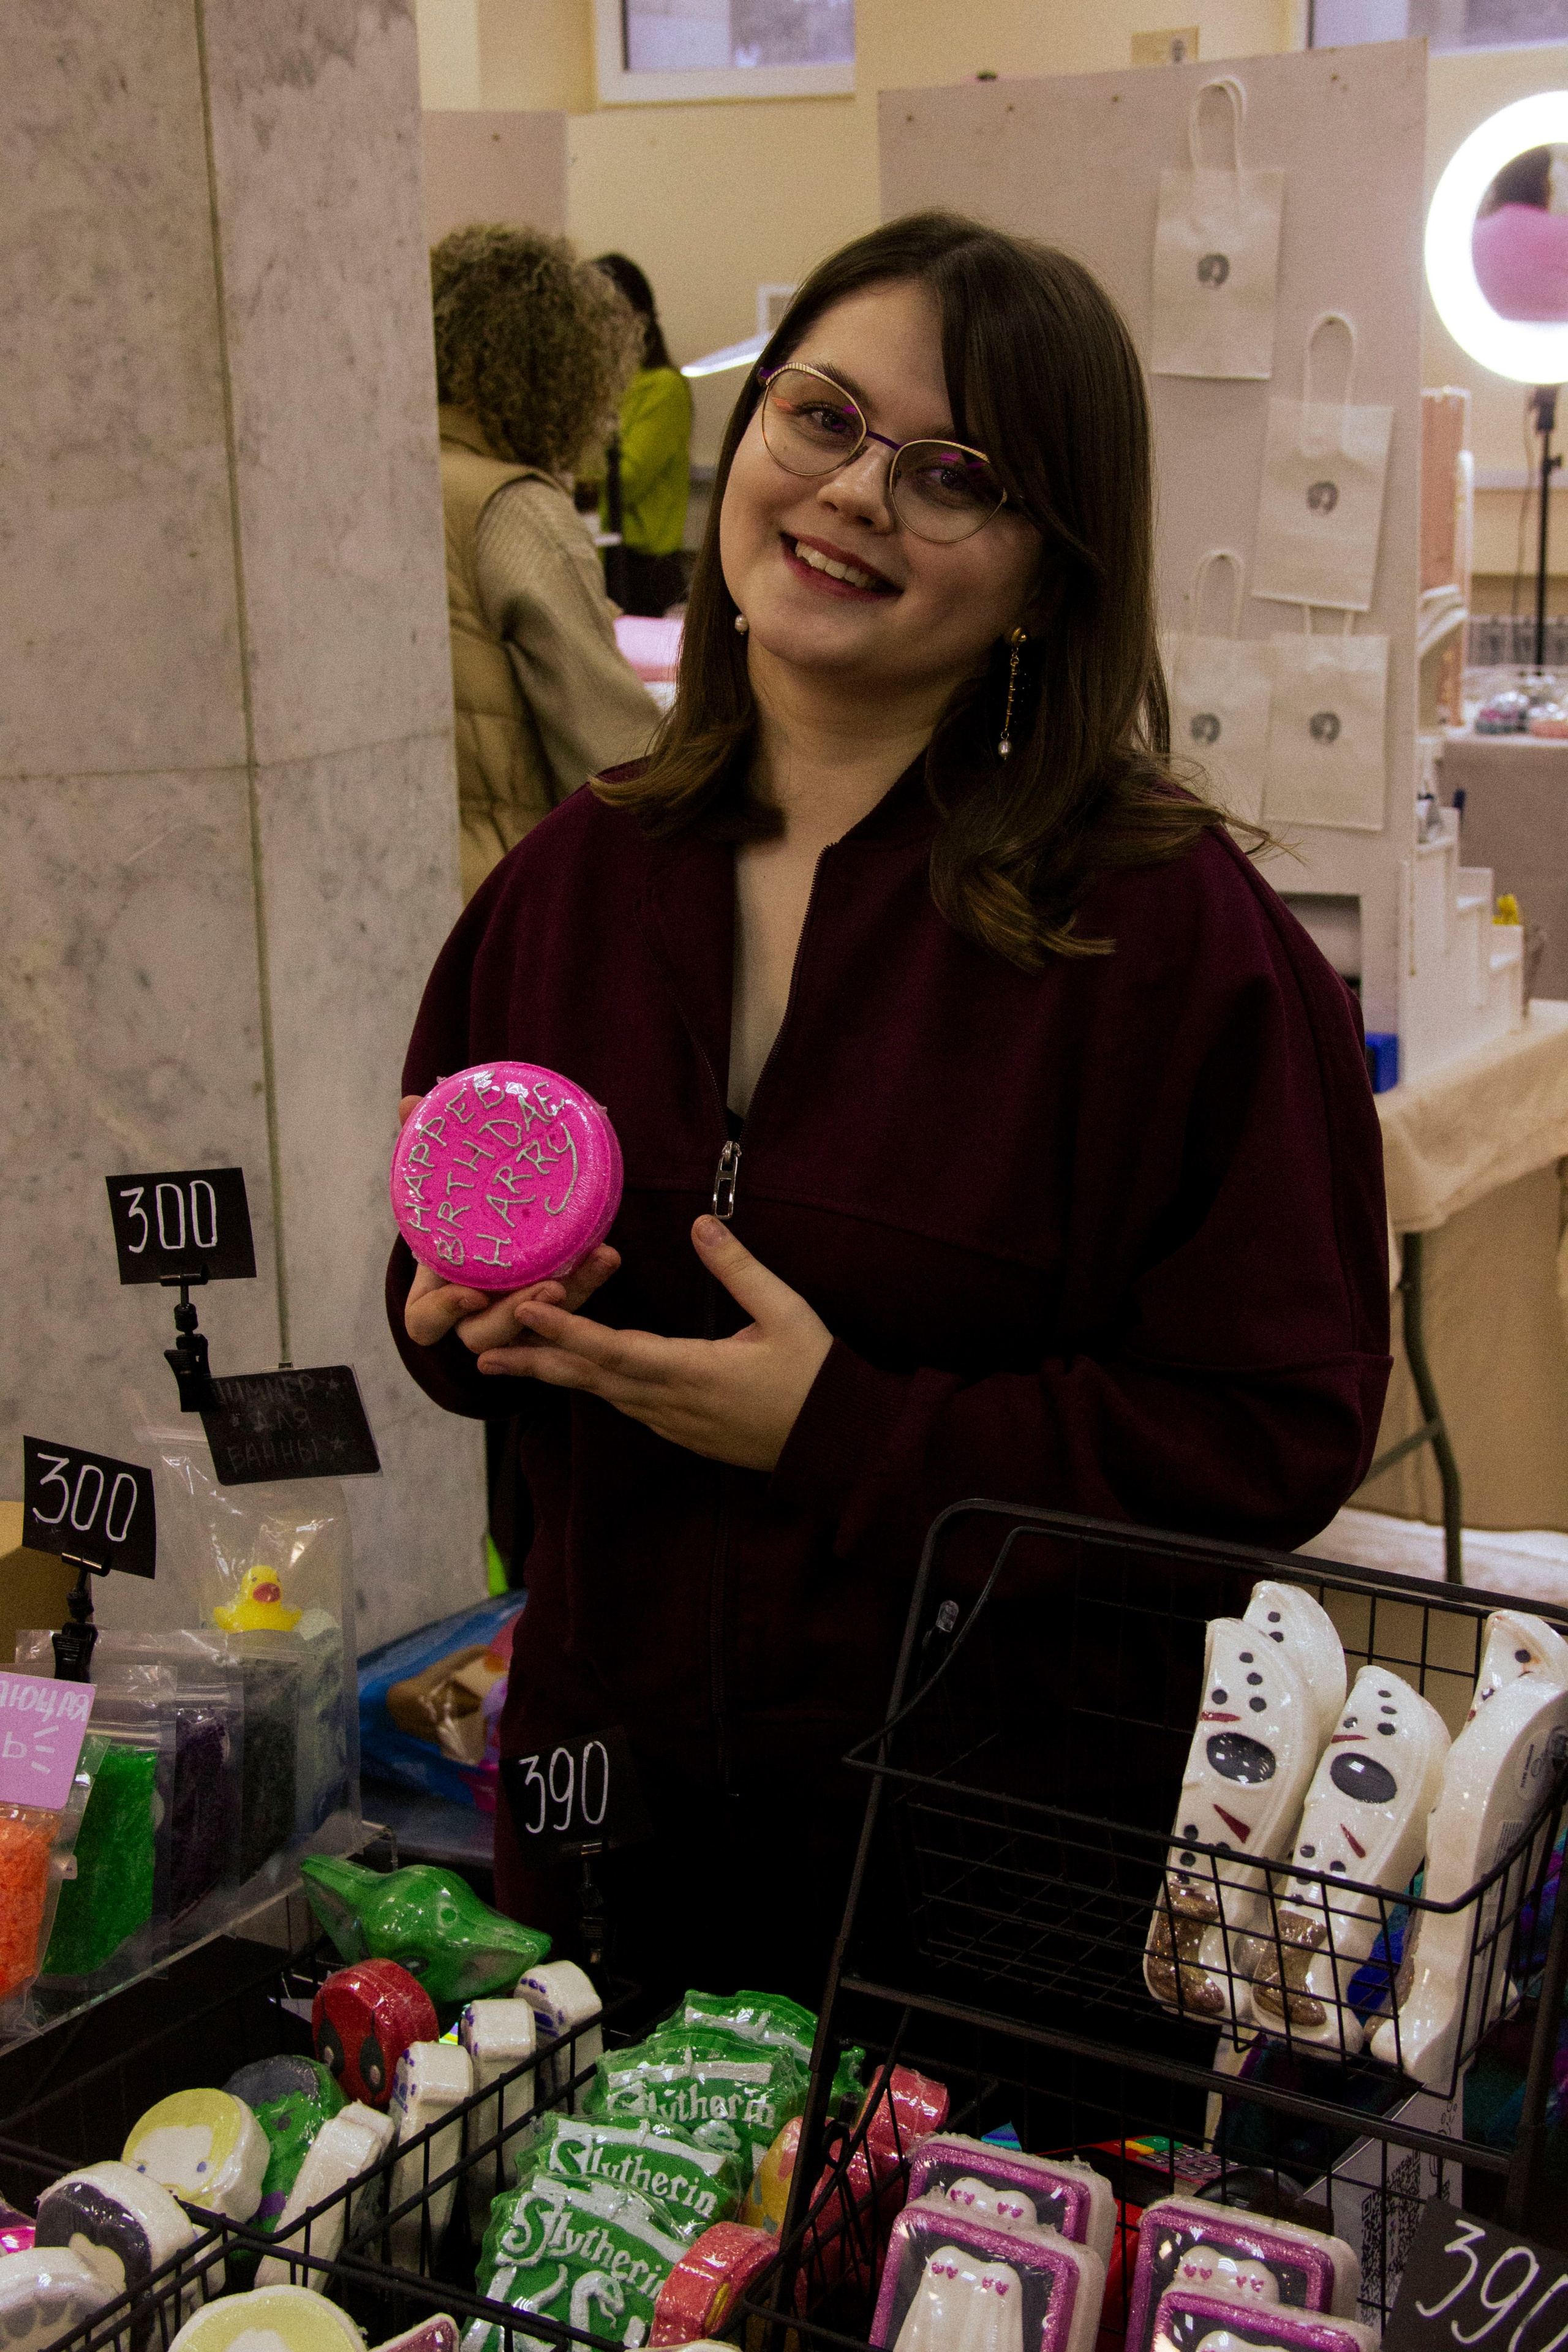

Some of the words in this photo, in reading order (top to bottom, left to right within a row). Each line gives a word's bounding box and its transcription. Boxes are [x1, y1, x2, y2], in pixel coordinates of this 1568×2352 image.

[404, 1070, 505, 1232] HAPPEE
[436, 1081, 565, 1267] BIRTHDAE
[120, 1180, 217, 1253] 300
[32, 1452, 138, 1542] 300
[518, 1740, 609, 1834] 390
